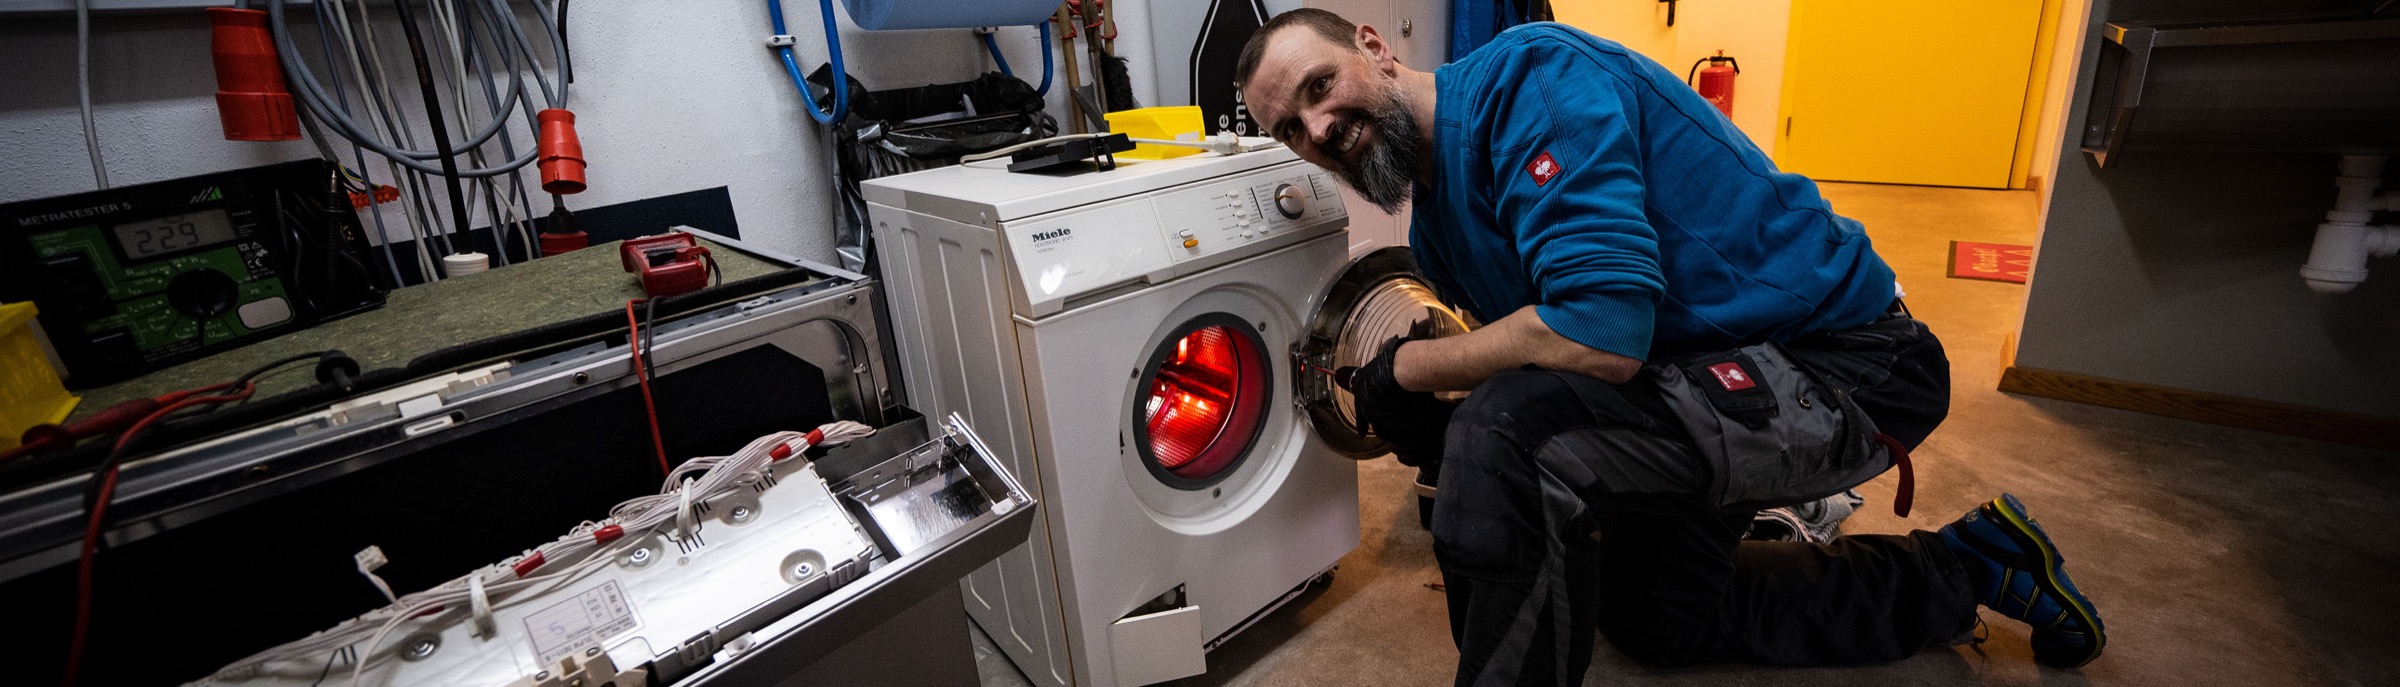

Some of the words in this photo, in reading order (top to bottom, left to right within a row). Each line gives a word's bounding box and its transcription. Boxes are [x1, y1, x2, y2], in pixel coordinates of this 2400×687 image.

[18, 203, 120, 227] METRATESTER
[122, 201, 132, 211] 5
[135, 221, 201, 255] 229
[1031, 228, 1072, 243] Miele
